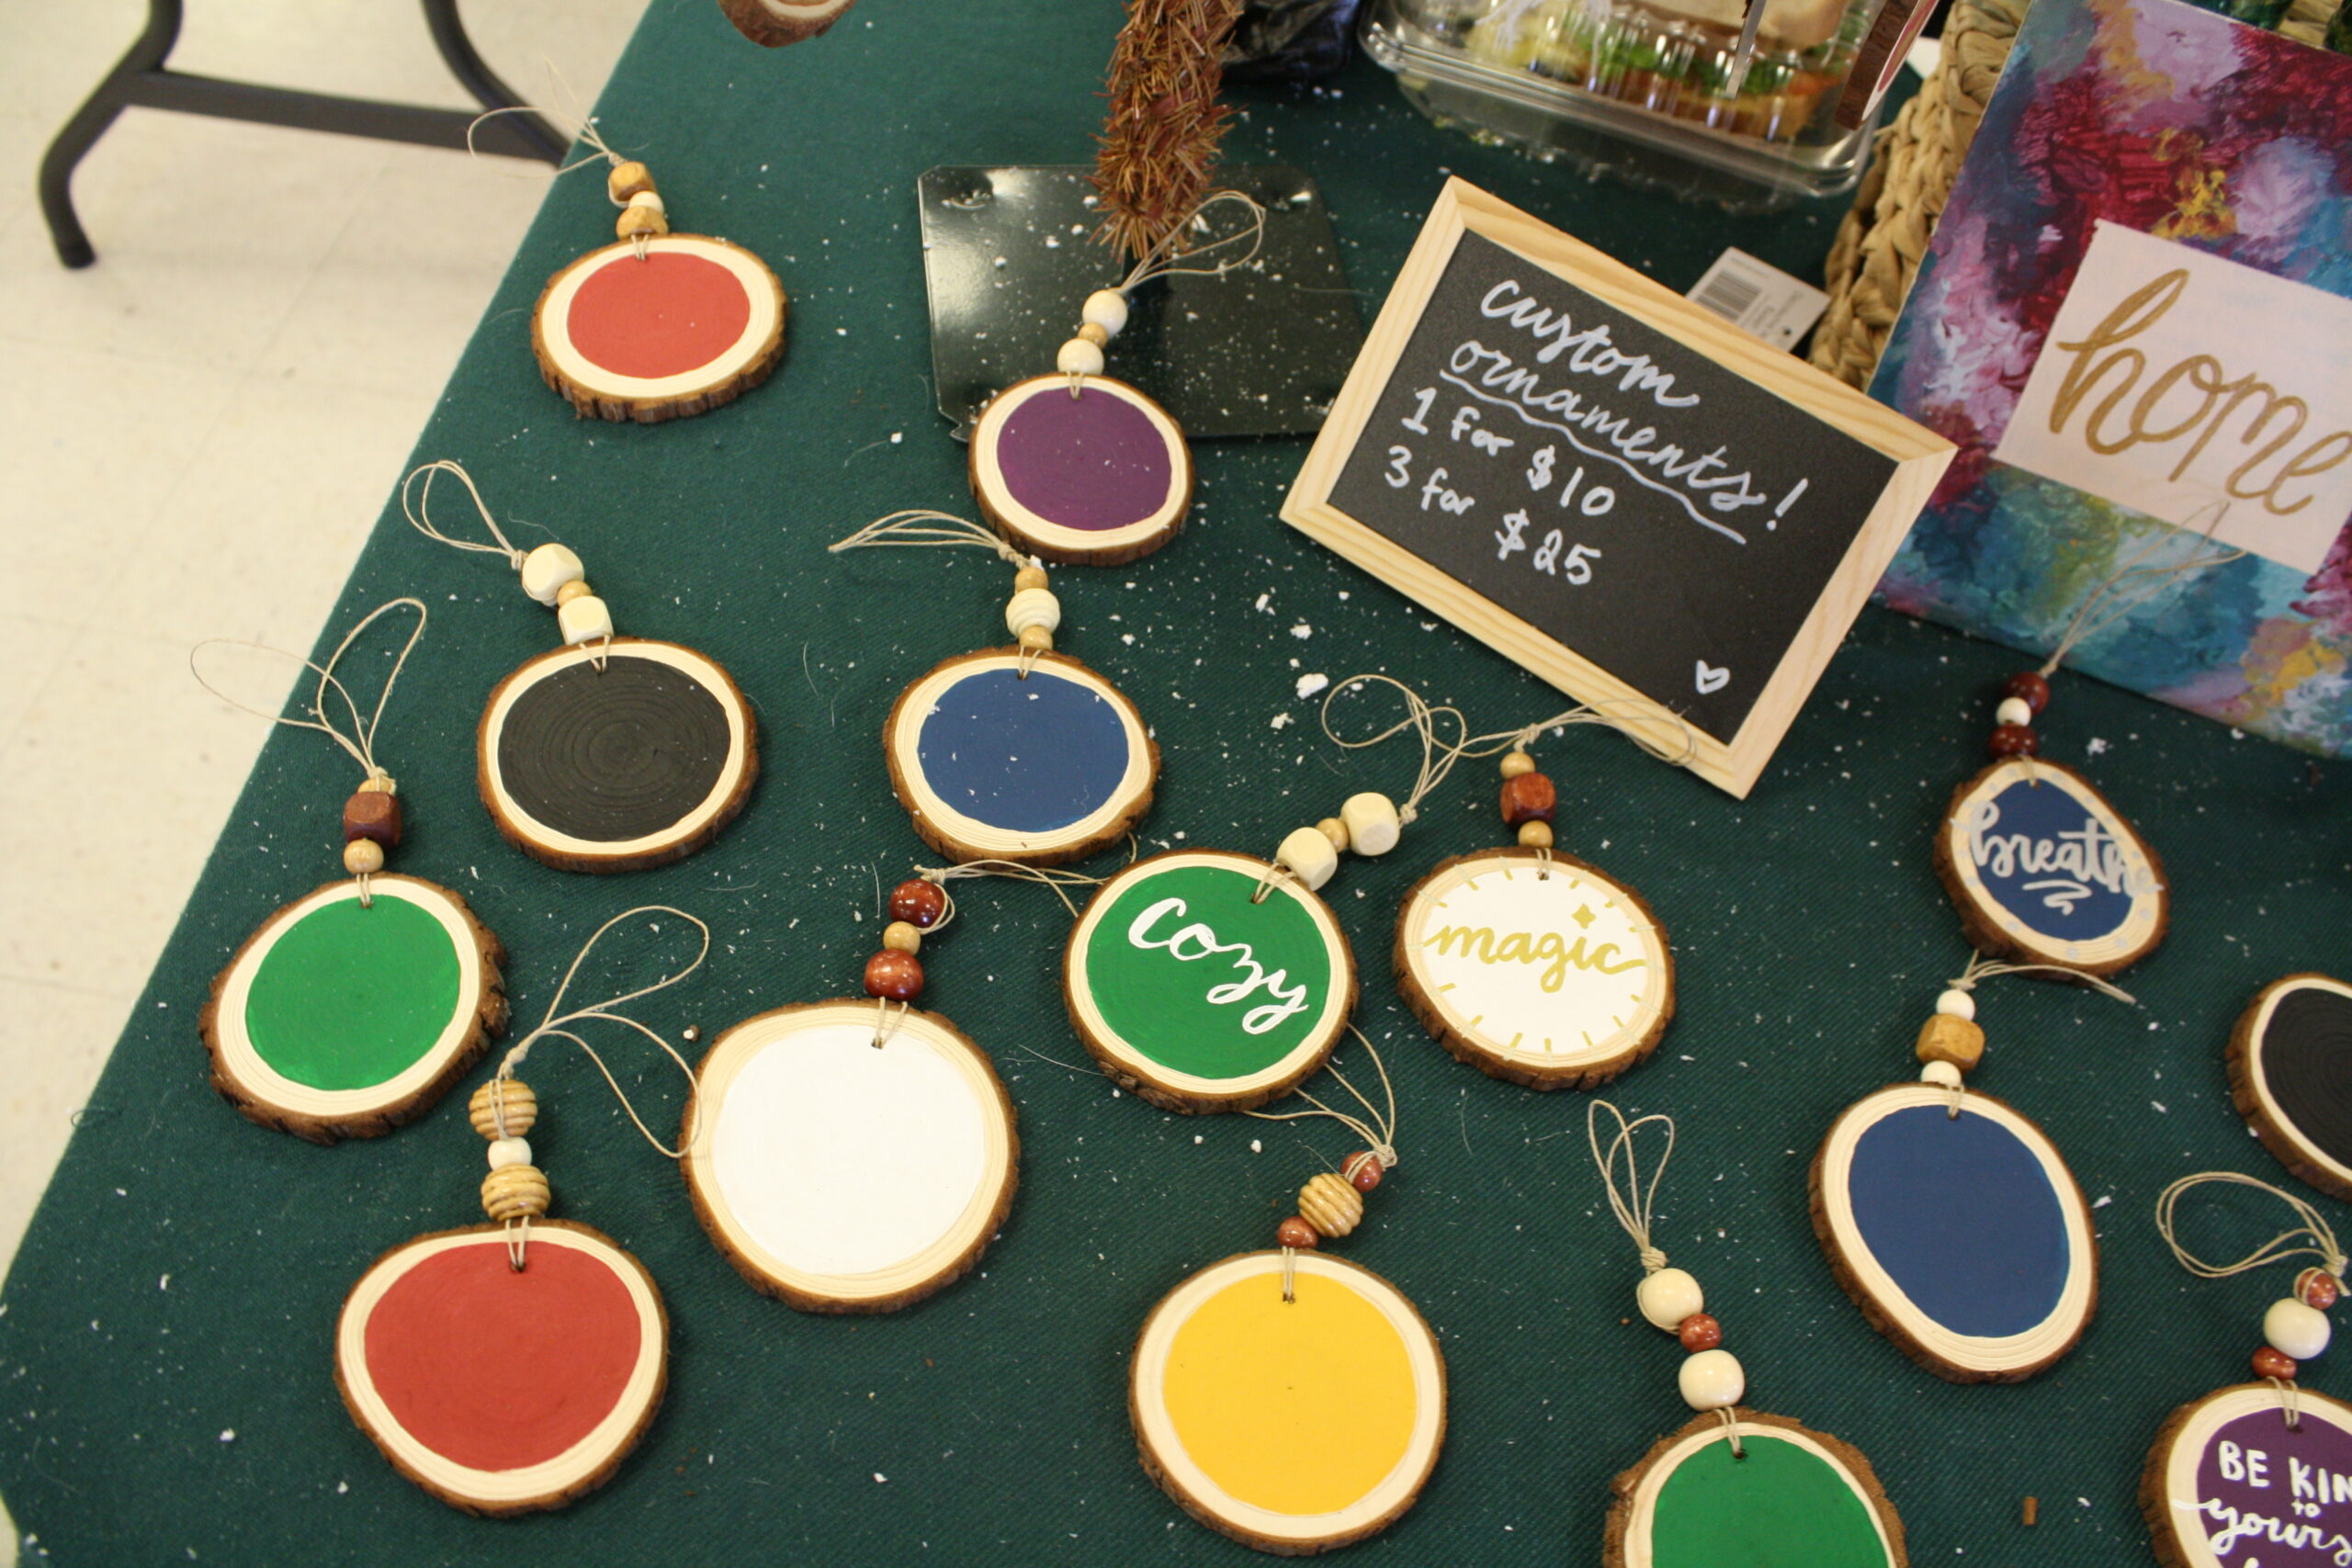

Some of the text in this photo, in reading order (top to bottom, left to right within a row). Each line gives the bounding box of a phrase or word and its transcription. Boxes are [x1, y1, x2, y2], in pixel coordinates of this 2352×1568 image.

[1480, 279, 1701, 407] custom
[2049, 268, 2352, 514] home
[1384, 446, 1601, 586] 3 for $25
[1402, 388, 1439, 435] 1
[1526, 446, 1615, 516] $10
[1426, 904, 1647, 993] magic
[2219, 1440, 2270, 1487] BE
